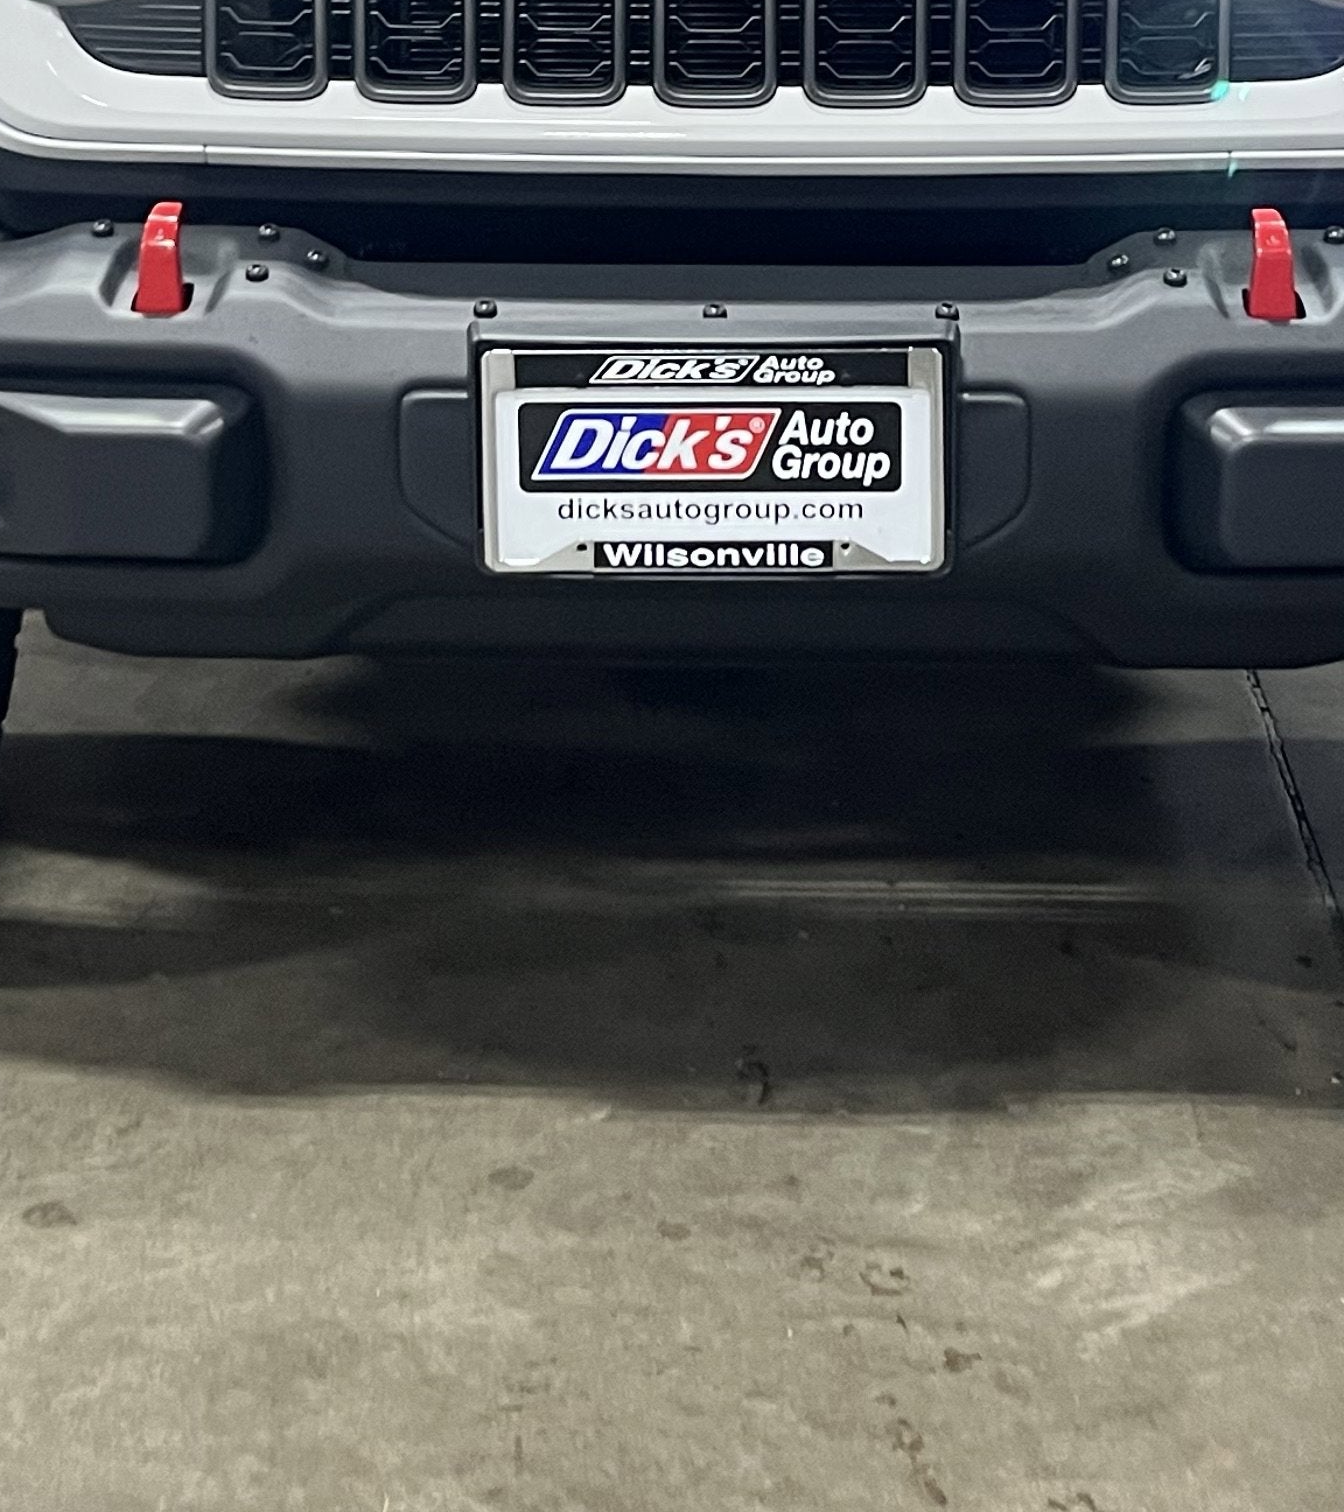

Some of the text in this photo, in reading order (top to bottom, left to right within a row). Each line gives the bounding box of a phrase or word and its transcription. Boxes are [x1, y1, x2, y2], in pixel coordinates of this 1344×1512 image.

[761, 355, 824, 371] Auto
[753, 368, 836, 386] Group
[779, 410, 874, 446] Auto
[771, 445, 891, 487] Group
[557, 498, 864, 525] dicksautogroup.com
[602, 542, 826, 568] Wilsonville
